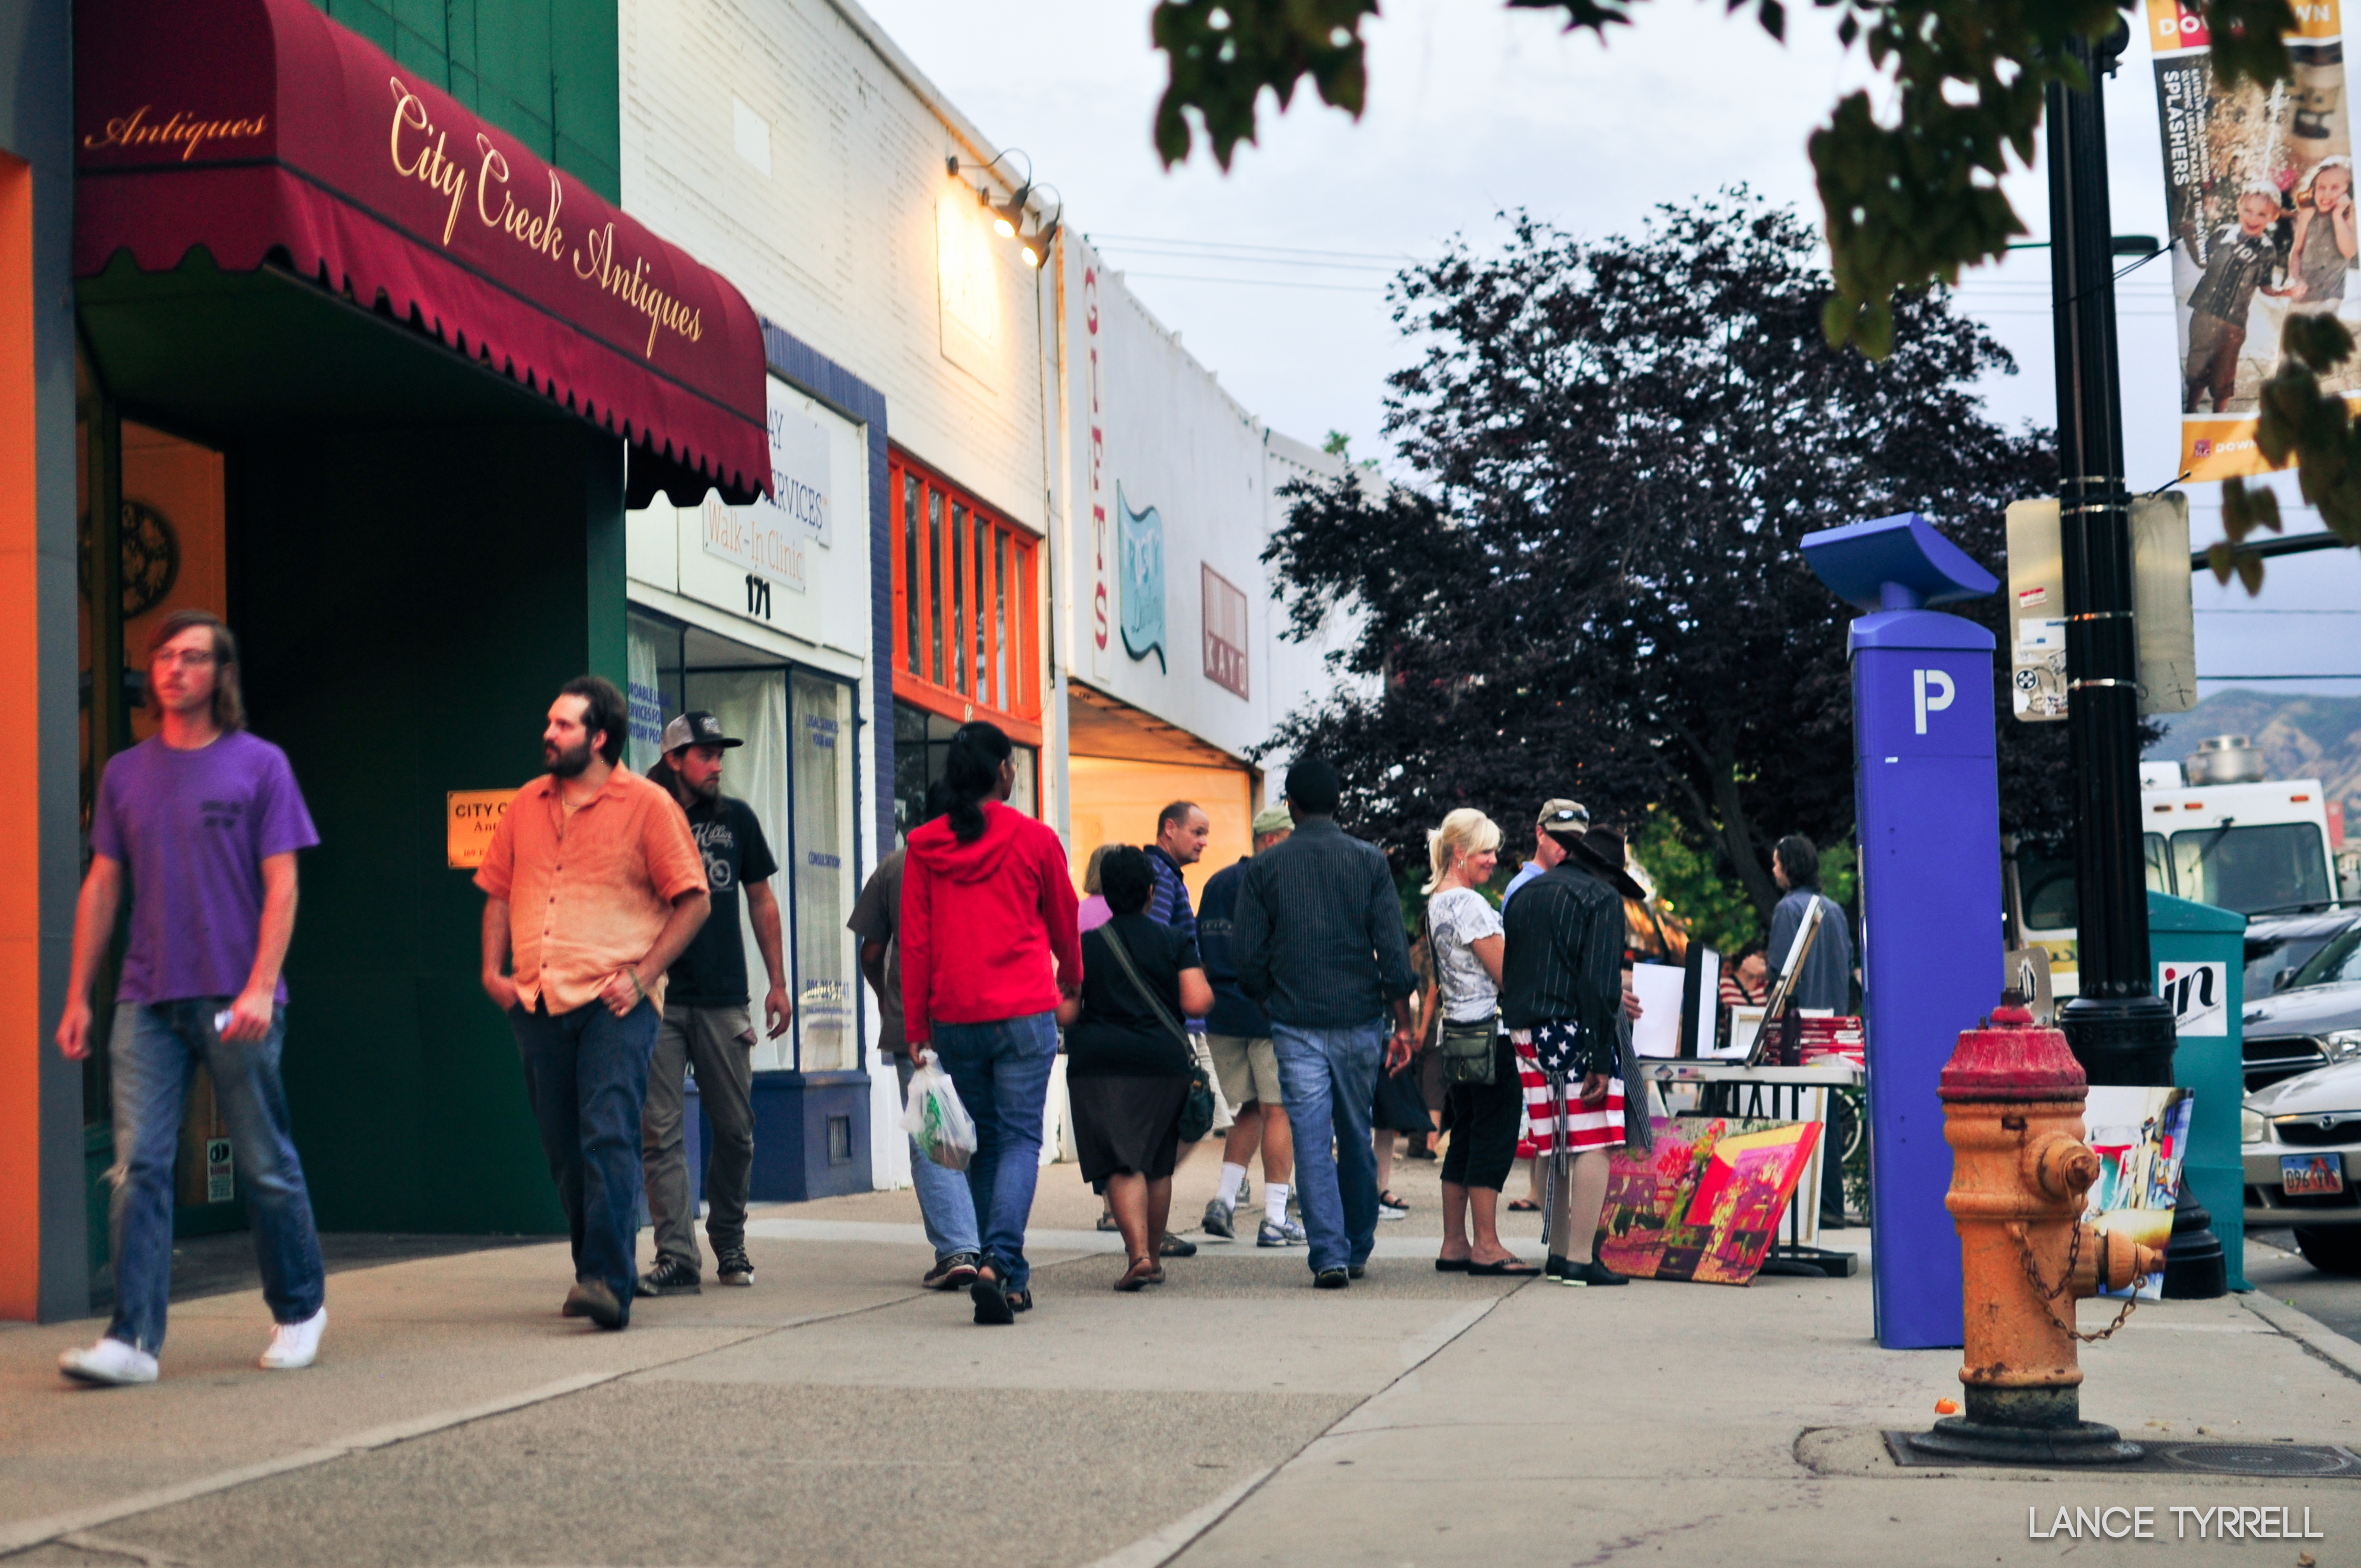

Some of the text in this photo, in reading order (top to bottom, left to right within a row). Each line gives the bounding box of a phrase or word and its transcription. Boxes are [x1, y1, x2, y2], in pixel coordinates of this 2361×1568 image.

[84, 104, 268, 161] Antiques
[2163, 70, 2190, 187] SPLASHERS
[390, 75, 704, 359] City Creek Antiques
[767, 407, 783, 450] AY
[1084, 266, 1108, 651] GIFTS
[763, 467, 823, 530] ERVICES
[767, 529, 803, 582] Clinic
[1122, 520, 1159, 587] FROSTY
[745, 573, 771, 620] 171
[1206, 634, 1245, 692] KAYO
[629, 681, 653, 704] RDABLE
[1913, 669, 1955, 735] P
[455, 803, 493, 817] CITY
[2164, 966, 2222, 1017] in
[2286, 1170, 2309, 1190] 096
